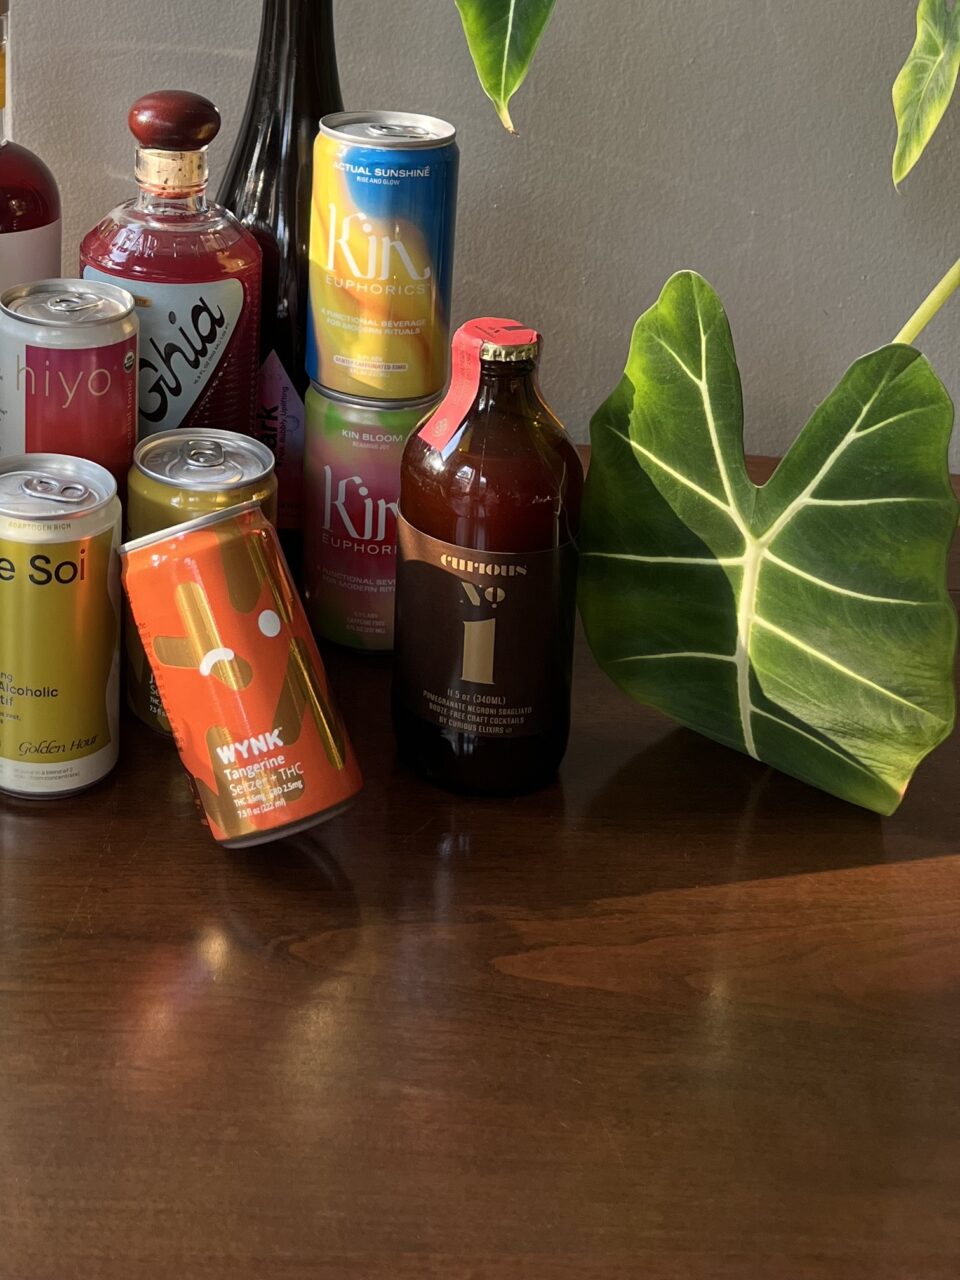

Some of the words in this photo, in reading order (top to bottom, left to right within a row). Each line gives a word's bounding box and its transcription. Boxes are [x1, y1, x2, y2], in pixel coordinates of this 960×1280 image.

[333, 161, 371, 176] ACTUAL
[374, 167, 430, 178] SUNSHINE
[327, 202, 431, 280] Kin
[325, 275, 426, 296] EUPHORICS
[326, 308, 378, 326] FUNCTIONAL
[381, 318, 427, 328] BEVERAGE
[327, 318, 342, 326] FOR
[343, 321, 382, 335] MODERN
[384, 327, 421, 335] RITUALS
[140, 296, 225, 423] Ghia
[16, 353, 112, 409] hiyo
[280, 386, 289, 417] Uplifting
[342, 429, 359, 440] KIN
[362, 433, 403, 442] BLOOM
[8, 521, 52, 531] ADAPTOGEN
[54, 523, 71, 531] RICH
[29, 548, 85, 585] Soi
[440, 554, 527, 576] curious
[322, 568, 374, 585] FUNCTIONAL
[339, 580, 378, 592] MODERN
[460, 617, 496, 685] 1
[423, 689, 467, 711] POMEGRANATE
[467, 704, 497, 715] NEGRONI
[498, 706, 532, 715] SBAGLIATO
[447, 688, 461, 699] 11.5
[462, 693, 471, 701] oz
[473, 693, 506, 705] (340ML)
[439, 715, 447, 724] BY
[448, 718, 477, 732] CURIOUS
[478, 722, 504, 734] ELIXIRS
[467, 713, 488, 724] CRAFT
[489, 716, 525, 724] COCKTAILS
[18, 740, 66, 756] Golden
[70, 735, 98, 751] Hour
[216, 728, 284, 764] WYNK
[224, 754, 286, 781] Tangerine
[229, 778, 268, 796] Seltzer
[278, 762, 305, 781] THC
[283, 780, 304, 793] 2.5mg
[237, 809, 247, 818] 7.5
[253, 807, 261, 815] oz
